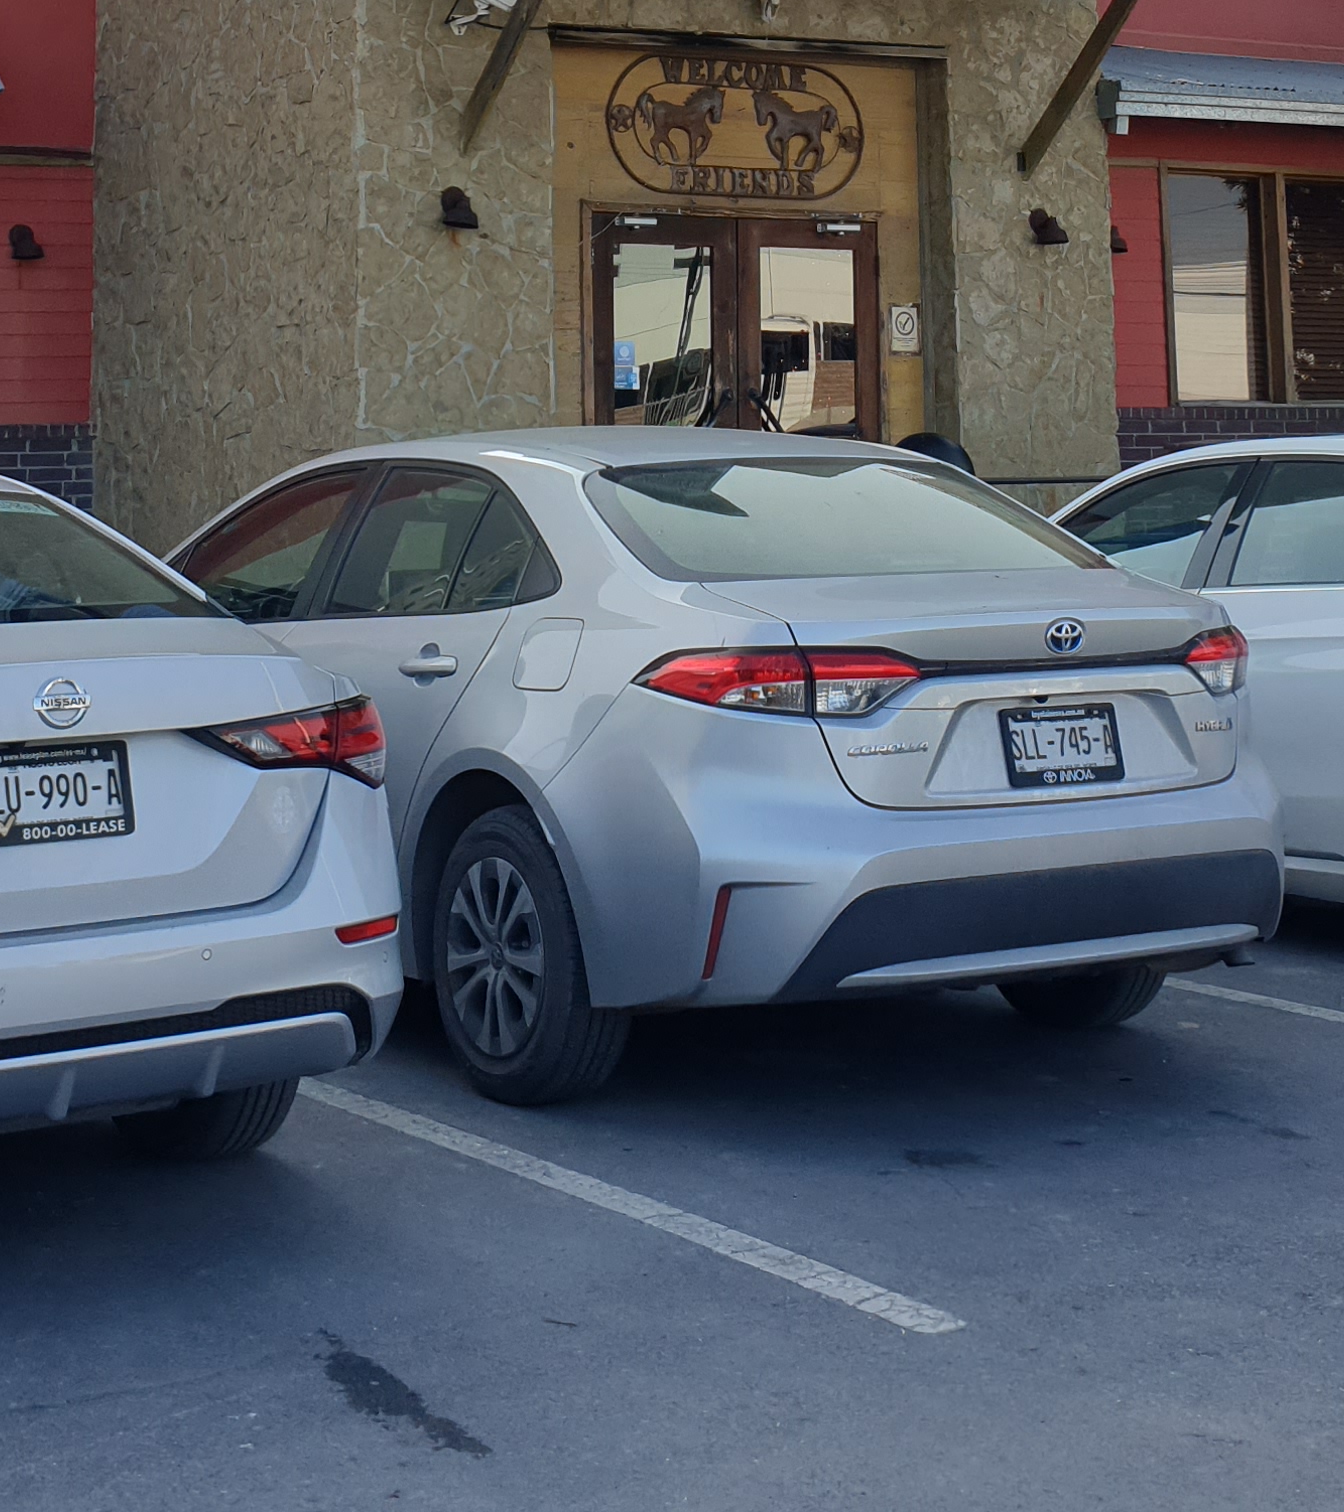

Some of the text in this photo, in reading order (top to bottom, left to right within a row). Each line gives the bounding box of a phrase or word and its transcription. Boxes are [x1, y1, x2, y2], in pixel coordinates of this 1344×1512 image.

[658, 55, 808, 92] WELCOME
[670, 165, 816, 197] FRIENDS
[40, 696, 87, 708] NISSAN
[1010, 724, 1116, 761] SLL-745-A
[21, 818, 127, 841] 800-00-LEASE
